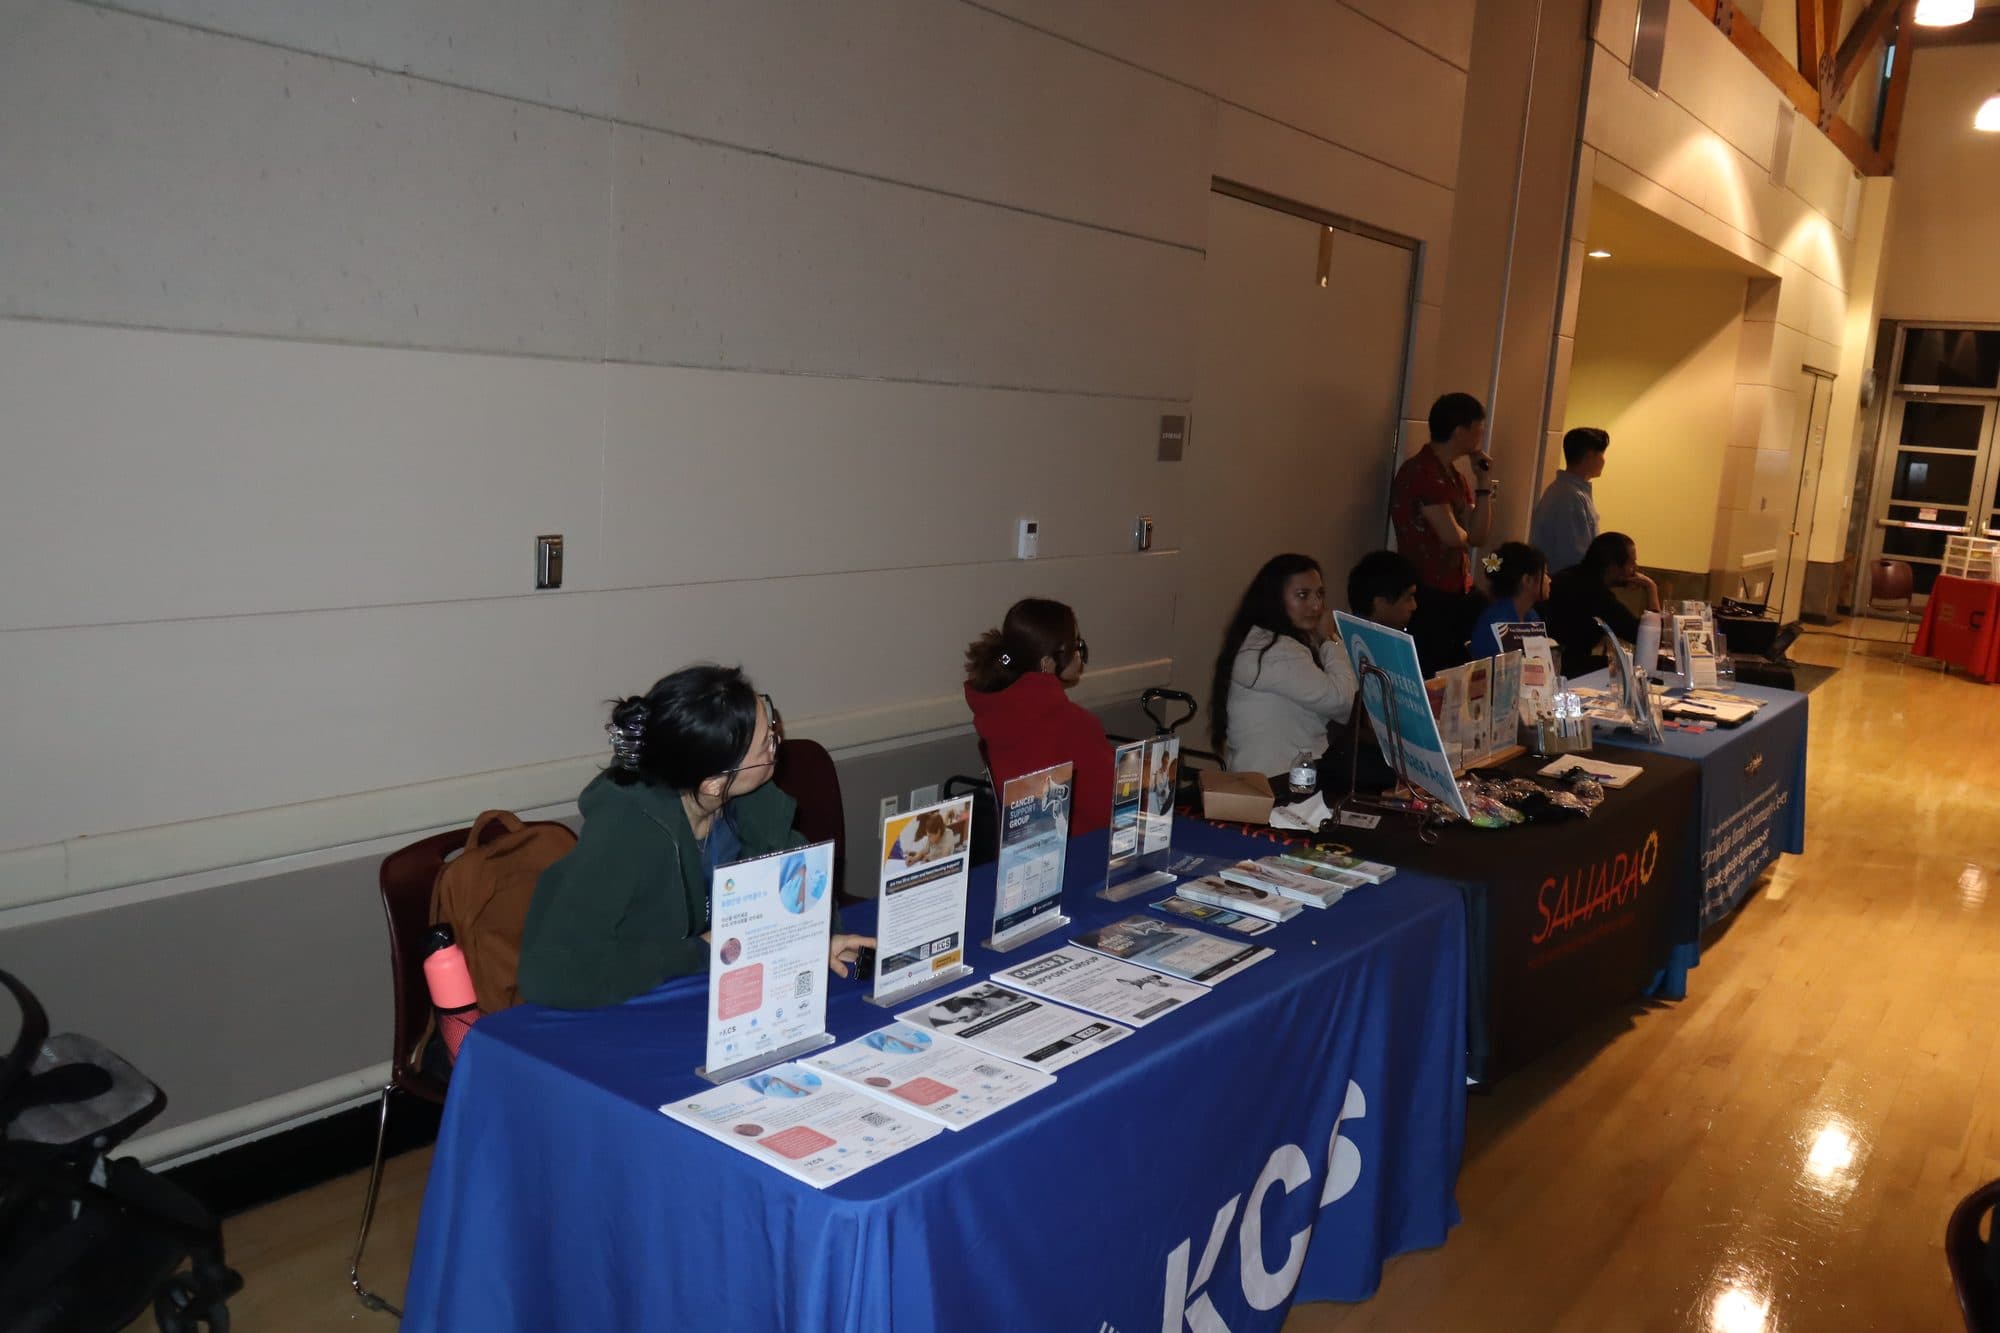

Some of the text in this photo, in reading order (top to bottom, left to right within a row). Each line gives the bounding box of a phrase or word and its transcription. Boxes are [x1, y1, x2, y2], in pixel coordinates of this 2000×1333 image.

[1011, 795, 1035, 810] CANCER
[1010, 803, 1036, 819] SUPPORT
[1009, 815, 1030, 829] GROUP
[1531, 851, 1640, 945] SAHARA
[1014, 961, 1055, 978] CANCER
[1027, 956, 1098, 986] SUPPORT GROUP
